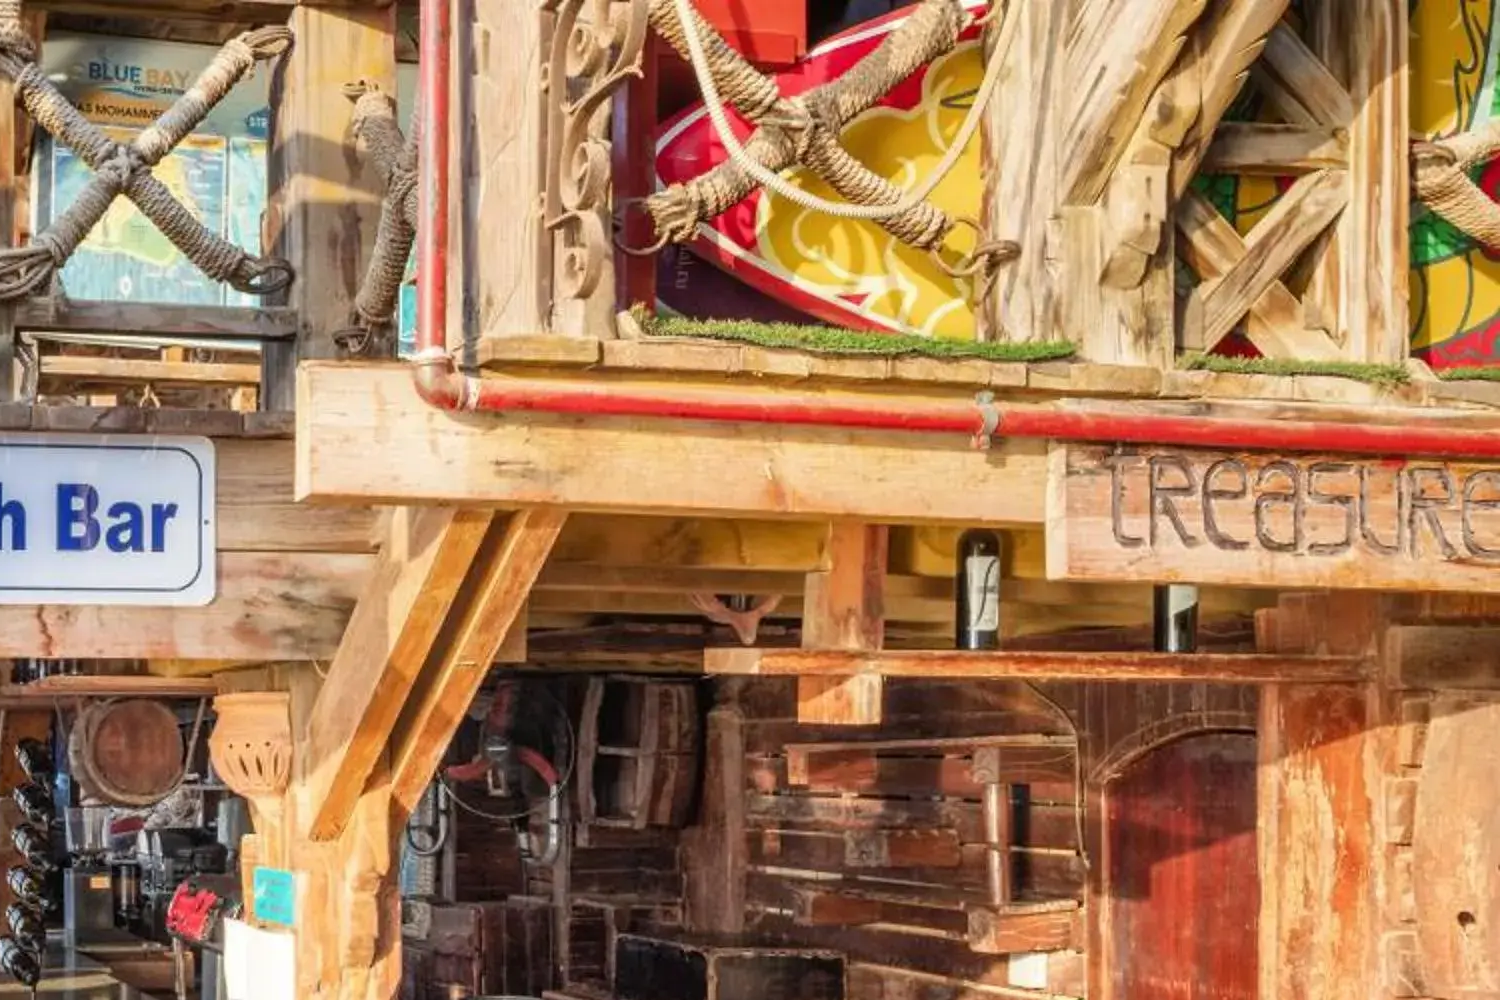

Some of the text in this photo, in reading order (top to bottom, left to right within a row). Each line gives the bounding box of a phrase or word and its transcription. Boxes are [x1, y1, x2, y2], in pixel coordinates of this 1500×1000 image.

[89, 61, 190, 88] BLUE BAY
[95, 103, 166, 120] MOHAMME
[675, 243, 696, 289] al.ru
[56, 483, 179, 554] Bar
